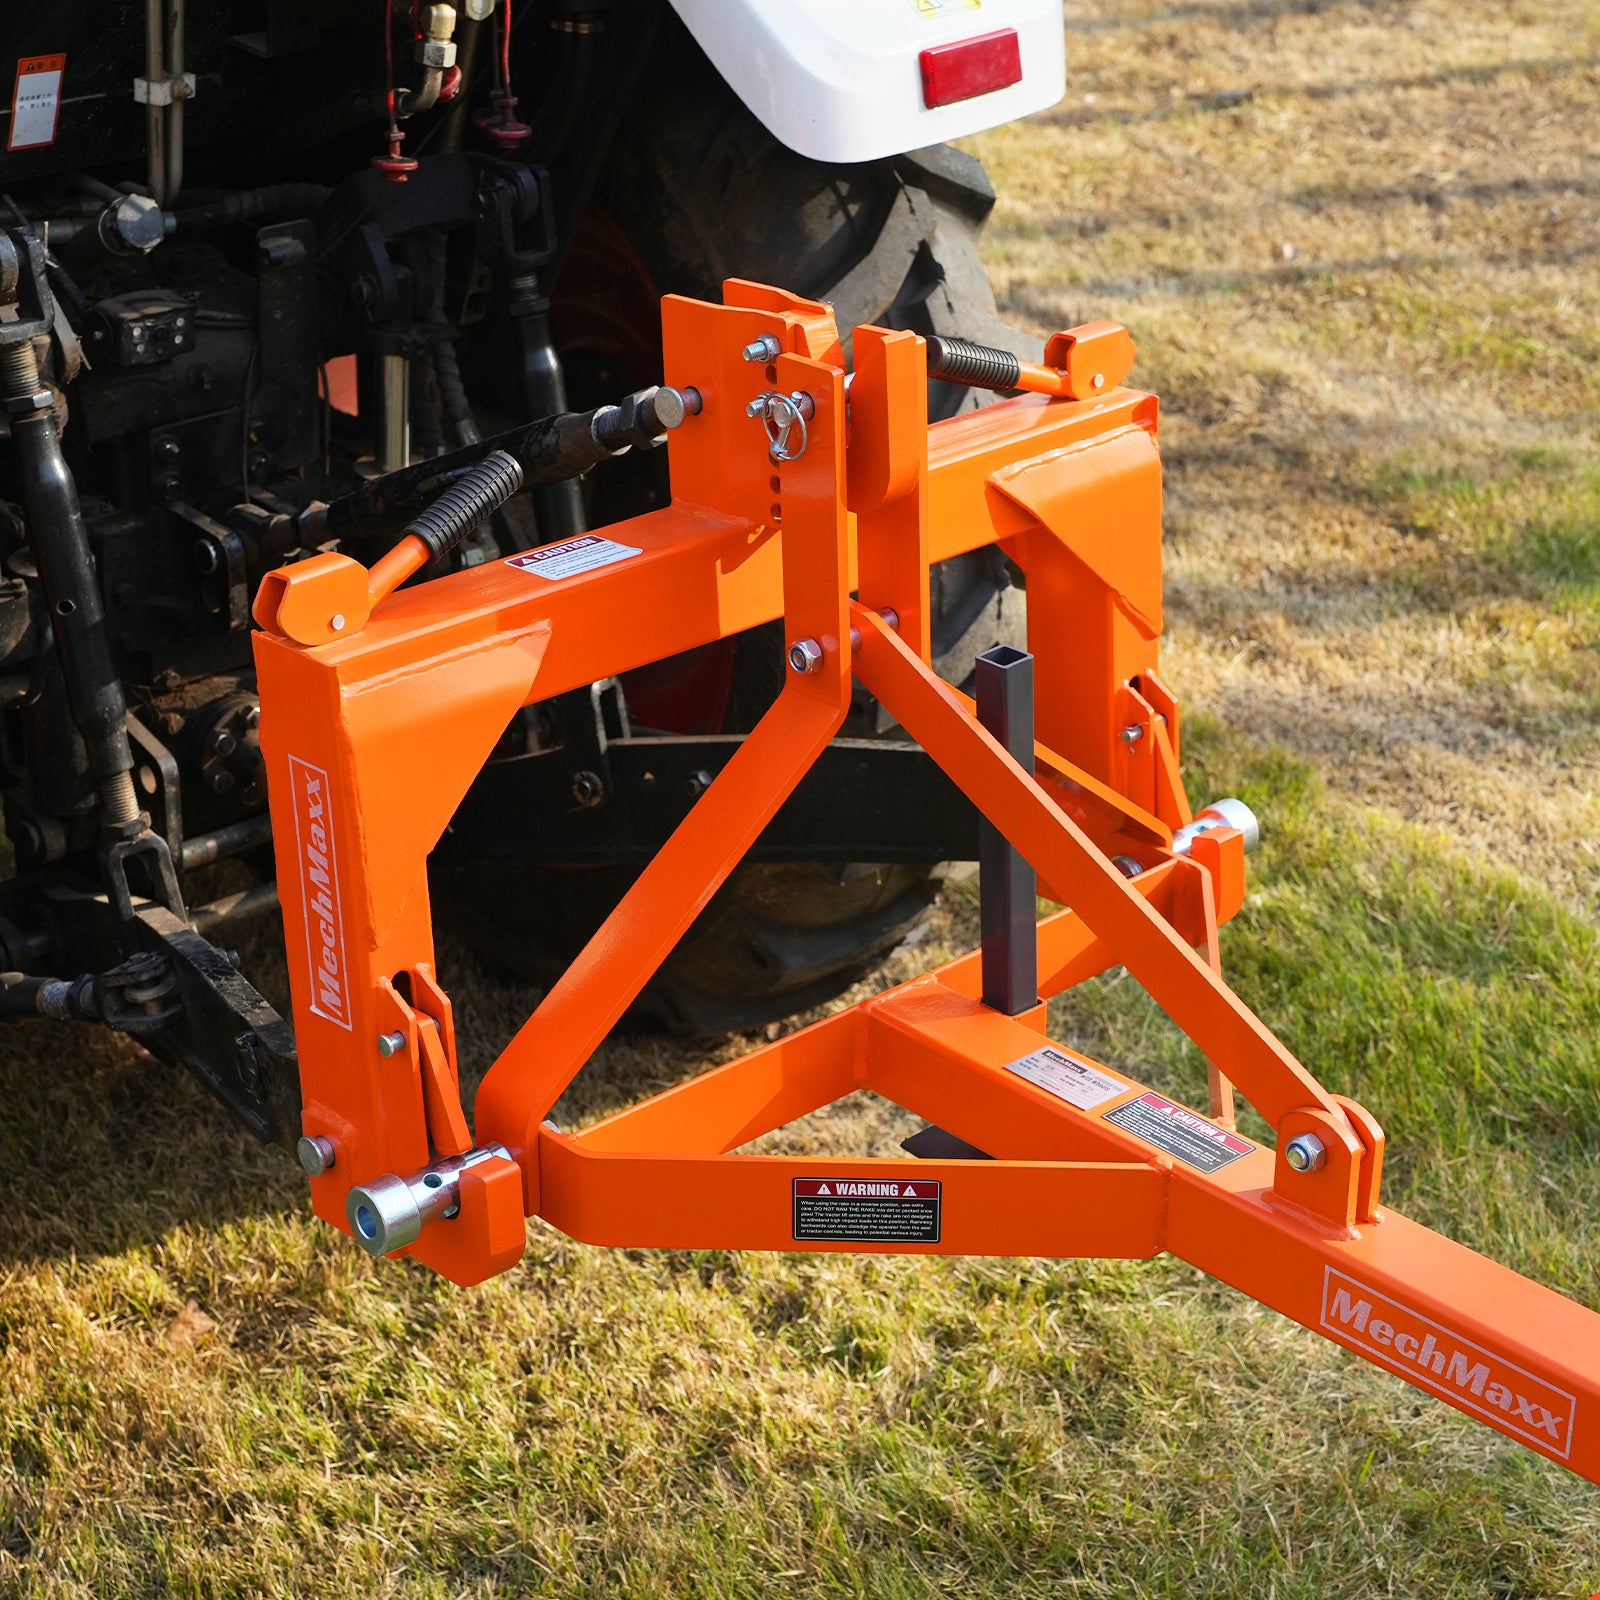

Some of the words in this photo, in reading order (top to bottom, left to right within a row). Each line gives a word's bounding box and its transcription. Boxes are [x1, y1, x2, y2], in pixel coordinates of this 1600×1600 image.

[533, 538, 598, 560] CAUTION
[305, 770, 343, 1017] MechMaxx
[1172, 1111, 1218, 1136] CAUTION
[836, 1183, 899, 1196] WARNING
[1330, 1288, 1564, 1439] MechMaxx
